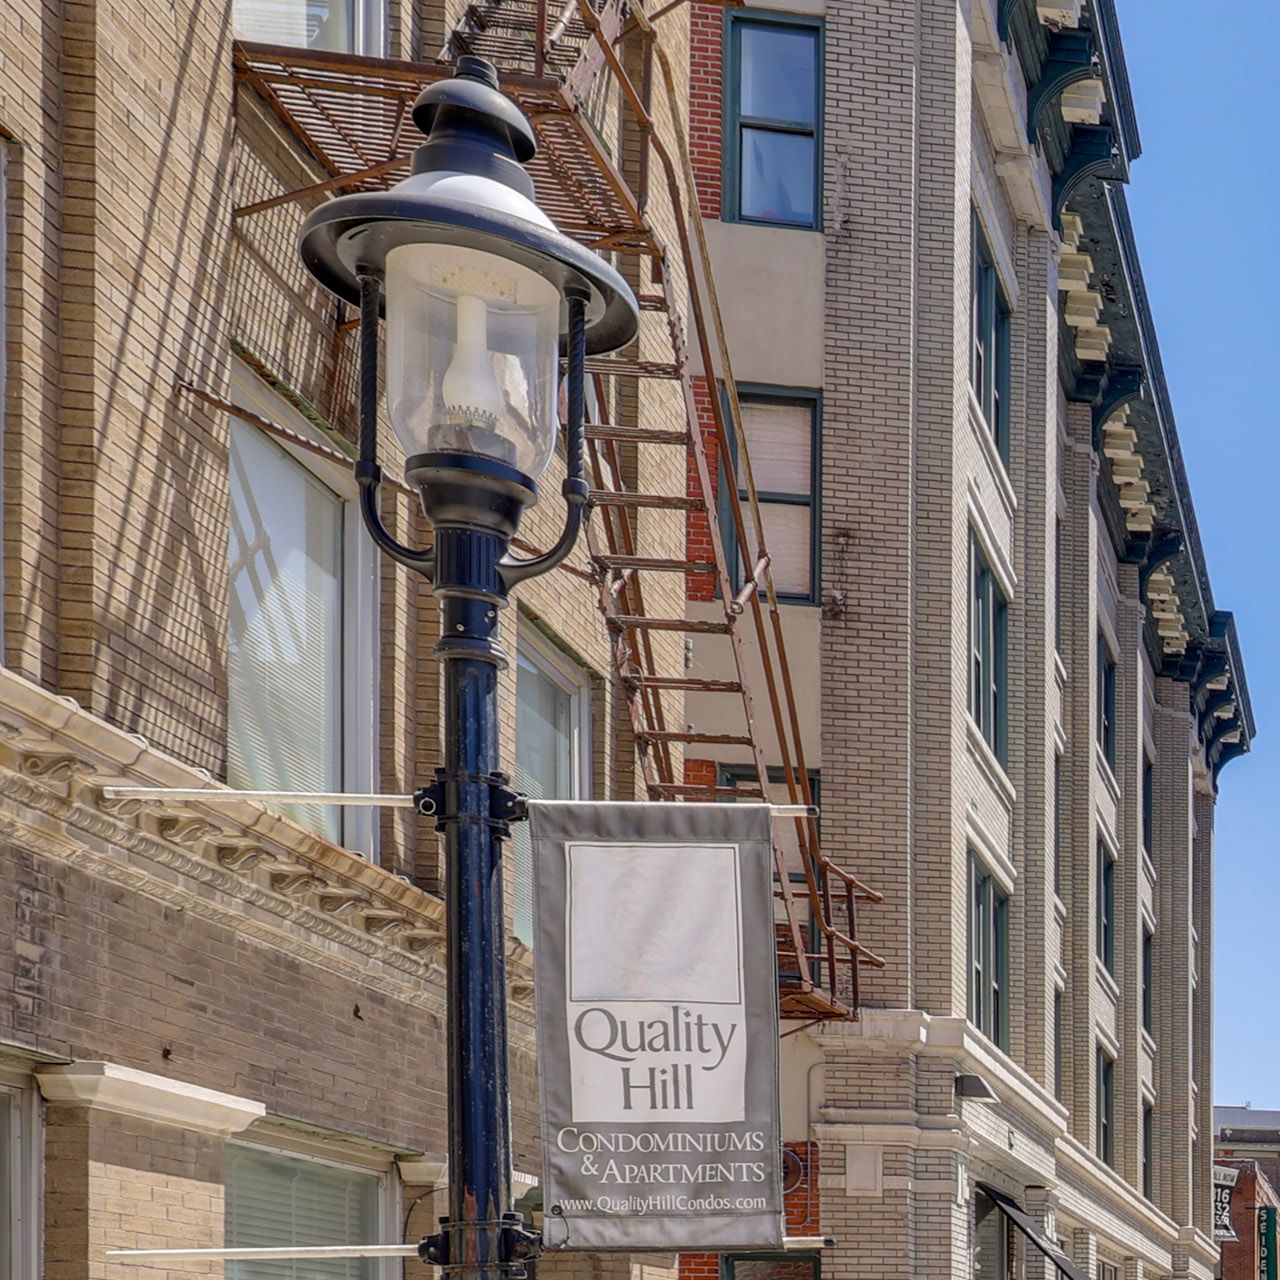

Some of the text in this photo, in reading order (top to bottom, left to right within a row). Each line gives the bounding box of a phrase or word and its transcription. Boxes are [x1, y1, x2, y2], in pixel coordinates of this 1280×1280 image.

[574, 1005, 737, 1071] Quality
[620, 1063, 694, 1110] Hill
[557, 1127, 764, 1153] CONDOMINIUMS
[559, 1194, 766, 1215] www.QualityHillCondos.com
